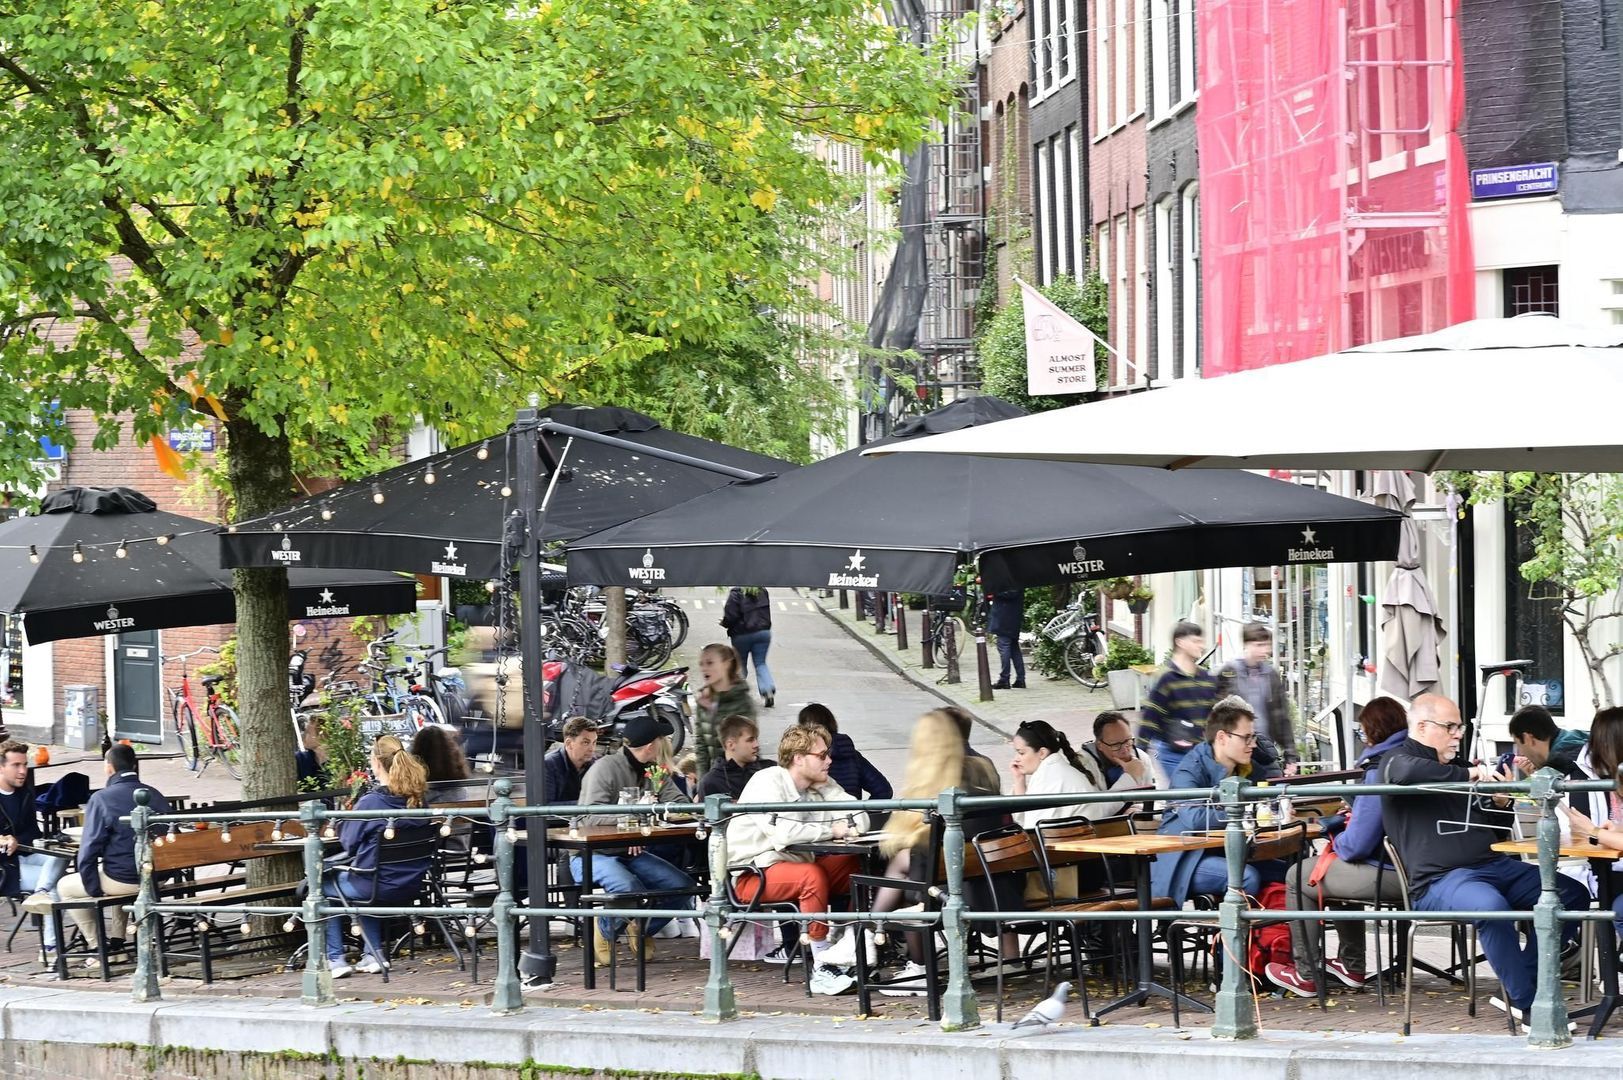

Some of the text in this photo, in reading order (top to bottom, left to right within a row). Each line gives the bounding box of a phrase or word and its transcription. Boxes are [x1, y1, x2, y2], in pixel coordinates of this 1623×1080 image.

[1475, 167, 1553, 186] PRINSENGRACHT
[1049, 354, 1086, 363] ALMOST
[1048, 364, 1086, 374] SUMMER
[1057, 375, 1087, 384] STORE
[271, 550, 301, 561] WESTER
[1288, 547, 1335, 561] Heineken
[431, 561, 467, 576] Heineken
[628, 567, 666, 580] WESTER
[1057, 560, 1105, 575] WESTER
[828, 573, 879, 587] Heineken
[305, 604, 350, 617] Heineken
[93, 617, 136, 631] WESTER
